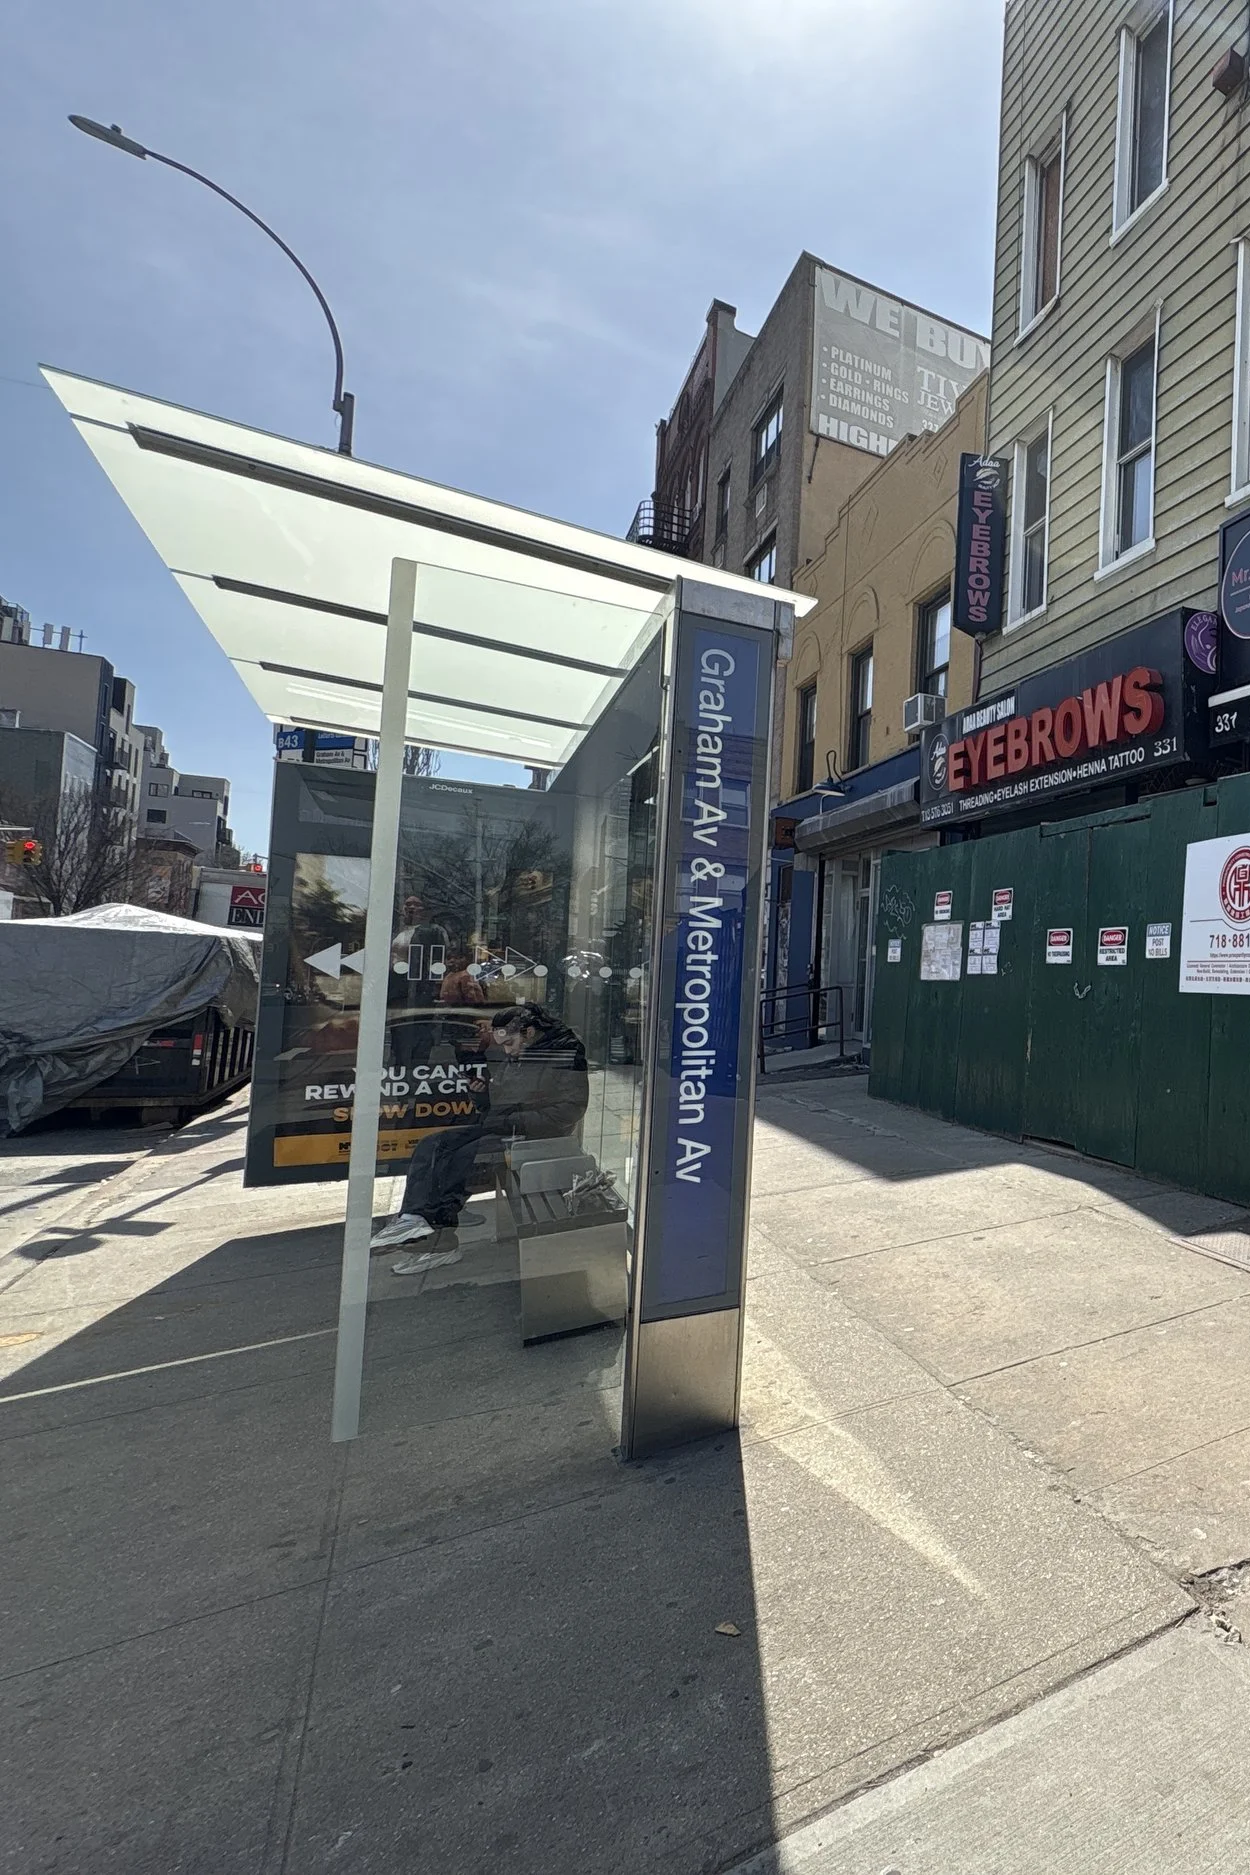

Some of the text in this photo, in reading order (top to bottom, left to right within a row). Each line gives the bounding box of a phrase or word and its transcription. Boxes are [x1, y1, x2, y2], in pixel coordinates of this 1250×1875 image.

[821, 271, 901, 339] WE
[831, 346, 892, 381] PLATINUM
[829, 378, 890, 412] EARRINGS
[830, 365, 909, 404] GOLD RINGS
[828, 394, 894, 429] DIAMONDS
[966, 490, 994, 623] EYEBROWS
[997, 696, 1016, 721] SALON
[948, 666, 1164, 792] EYEBROWS
[1214, 711, 1238, 733] 331
[278, 735, 298, 749] B43
[1108, 747, 1145, 771] TATTOO
[1154, 736, 1178, 757] 331
[675, 648, 735, 1184] Graham Av & Metropolitan Av
[1103, 934, 1123, 942] DANGER
[1148, 925, 1169, 935] NOTICE
[1152, 938, 1164, 946] POST
[1155, 948, 1168, 956] BILLS
[412, 1063, 487, 1080] CAN'T
[305, 1081, 410, 1101] REWND
[415, 1082, 432, 1096] A
[415, 1100, 481, 1118] DOW
